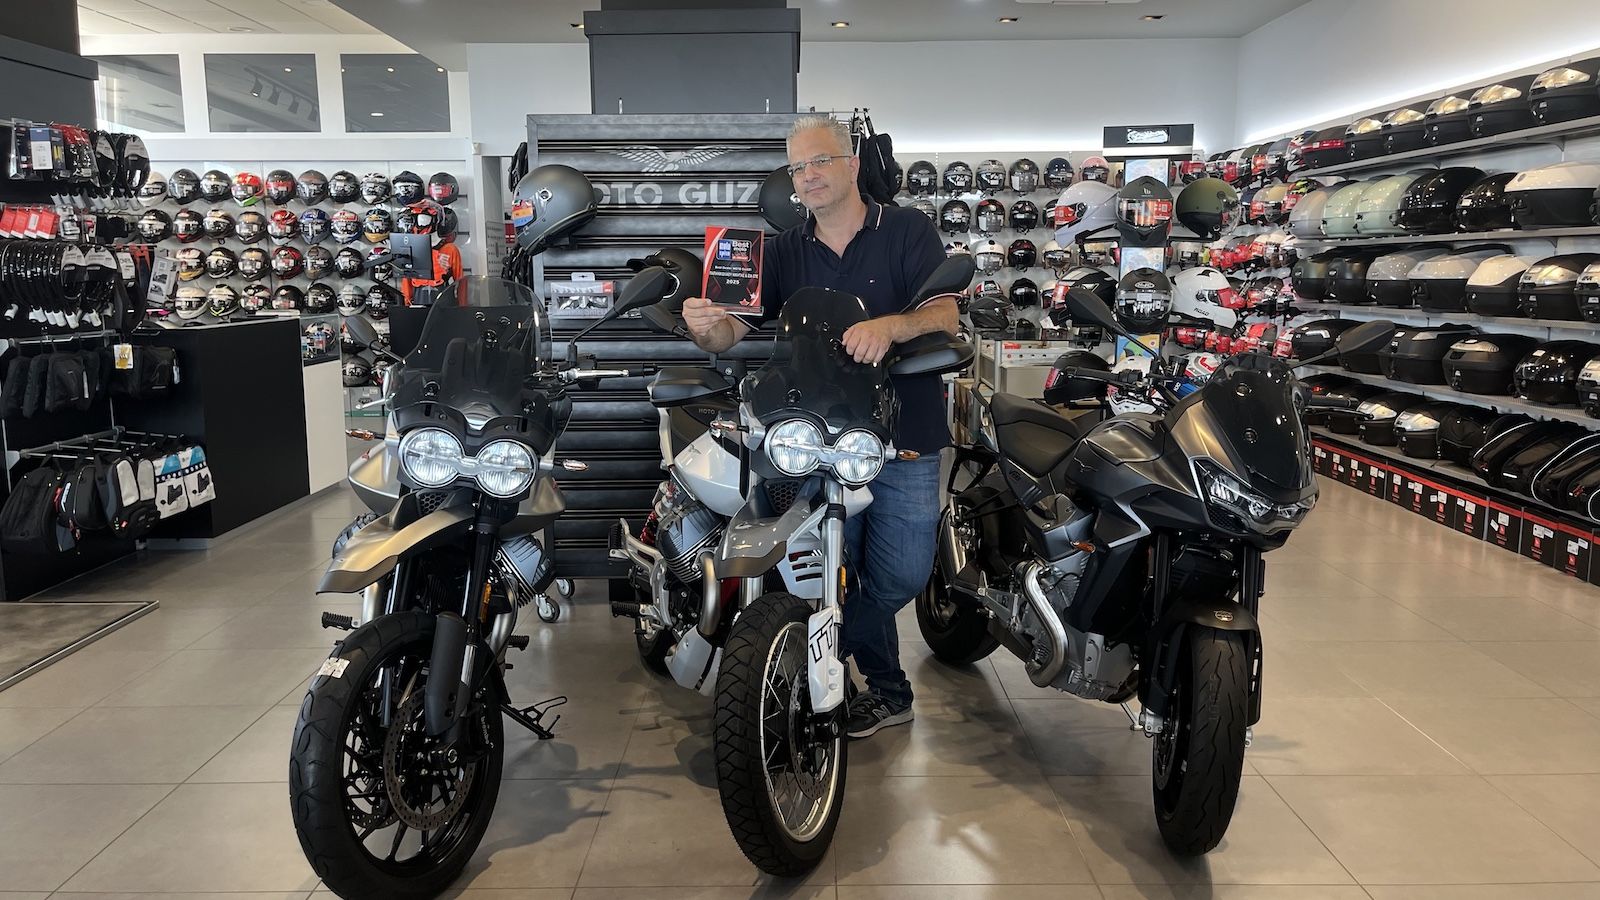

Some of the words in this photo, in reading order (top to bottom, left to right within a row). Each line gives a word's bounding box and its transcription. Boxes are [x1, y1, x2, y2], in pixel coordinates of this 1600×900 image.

[593, 182, 663, 208] OTO
[678, 181, 760, 208] GUZ
[809, 614, 834, 664] TT
[481, 716, 489, 744] brembo
